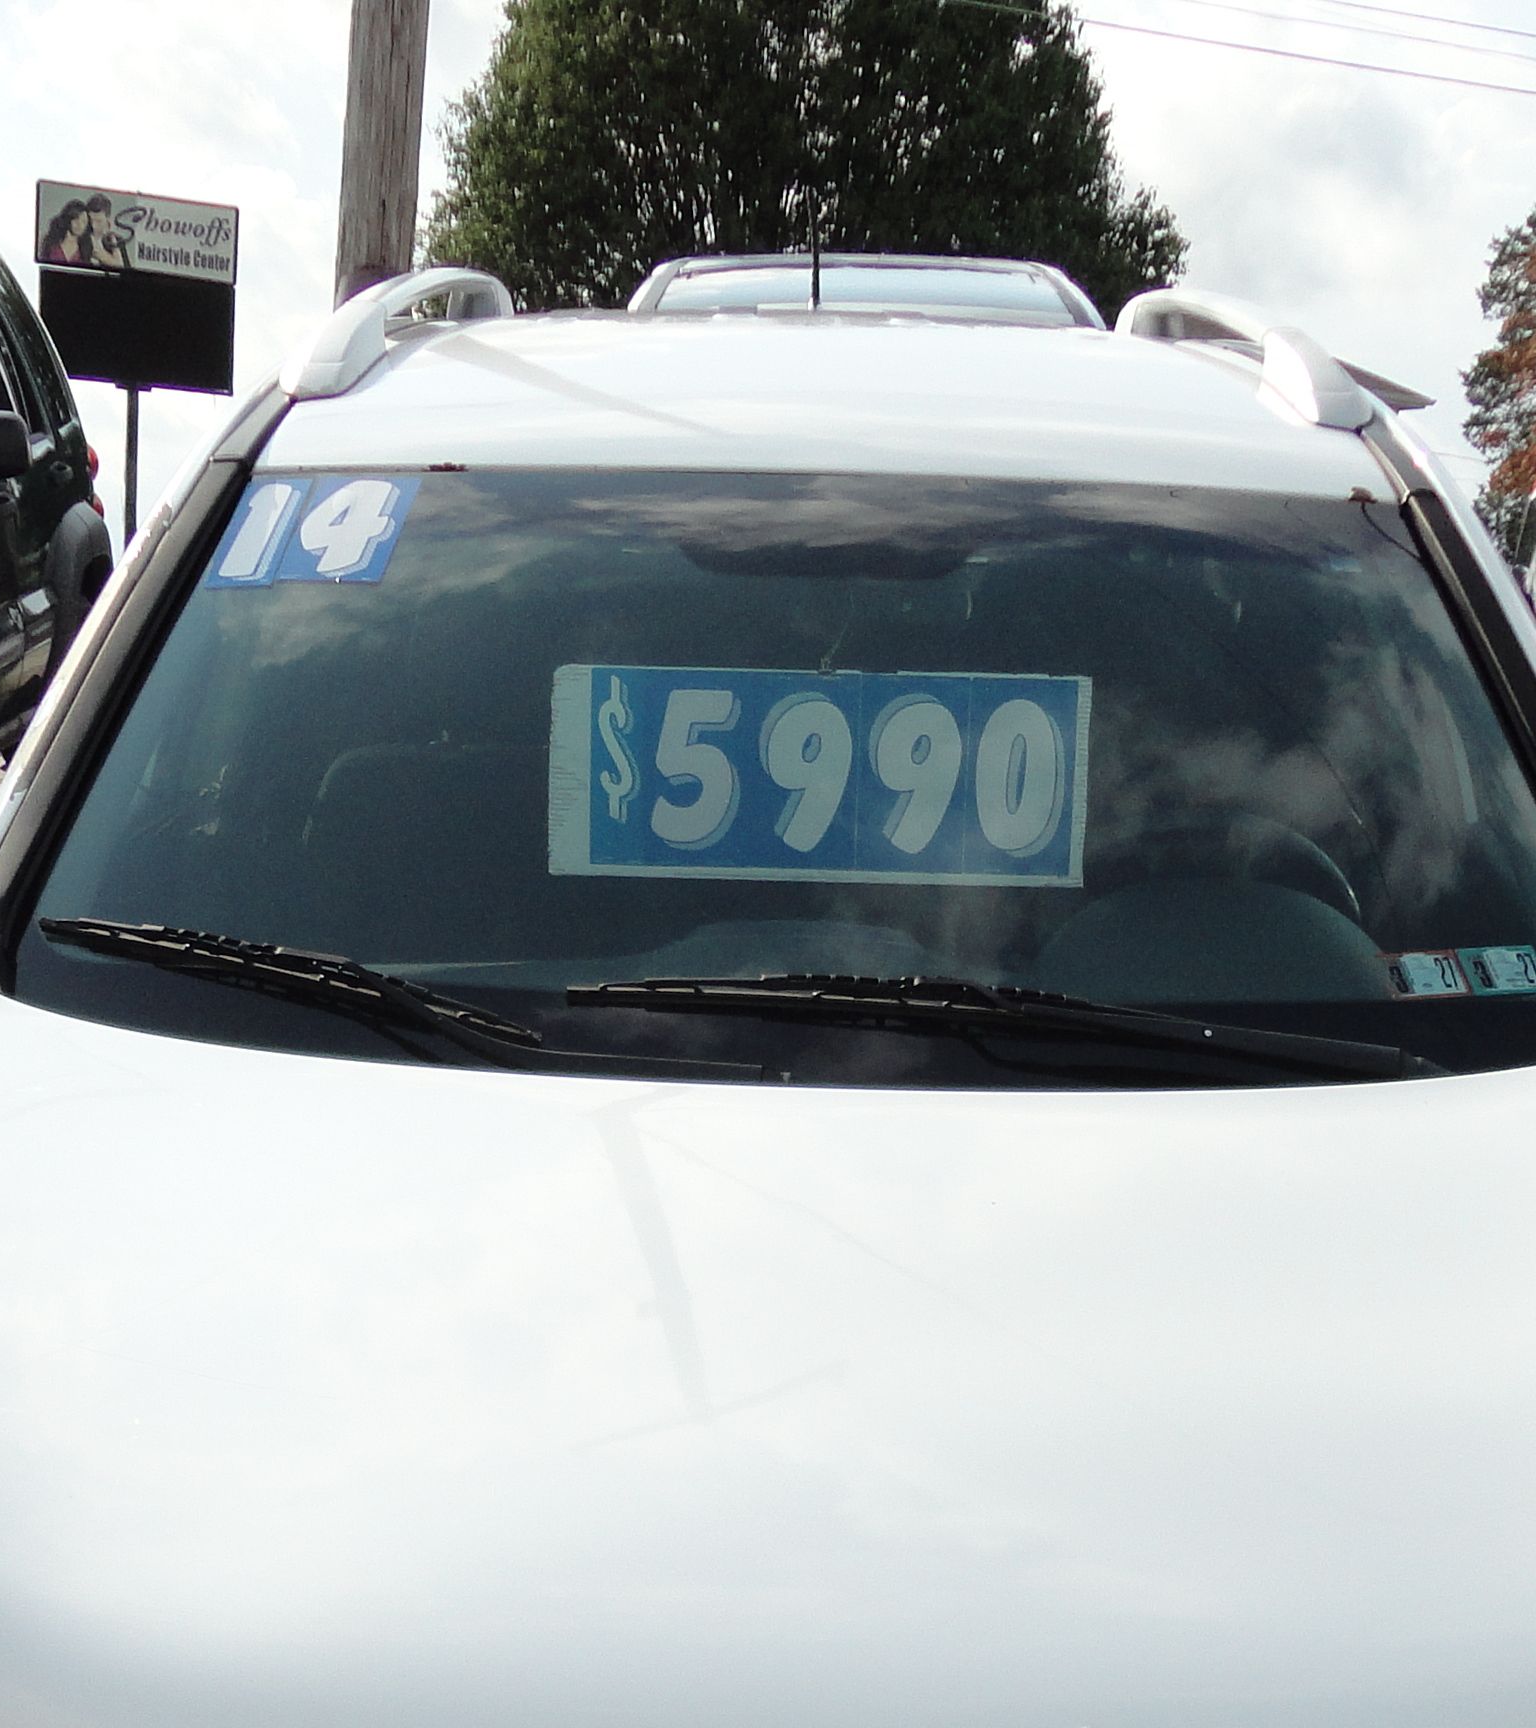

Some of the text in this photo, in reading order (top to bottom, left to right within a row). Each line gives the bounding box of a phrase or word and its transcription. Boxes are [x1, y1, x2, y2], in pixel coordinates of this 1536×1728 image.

[115, 206, 232, 247] Showoffs
[138, 242, 231, 272] Hairstyle Center
[218, 479, 400, 578] 14
[598, 676, 1064, 858] $5990
[1389, 965, 1409, 994] 3
[1473, 960, 1494, 988] 3
